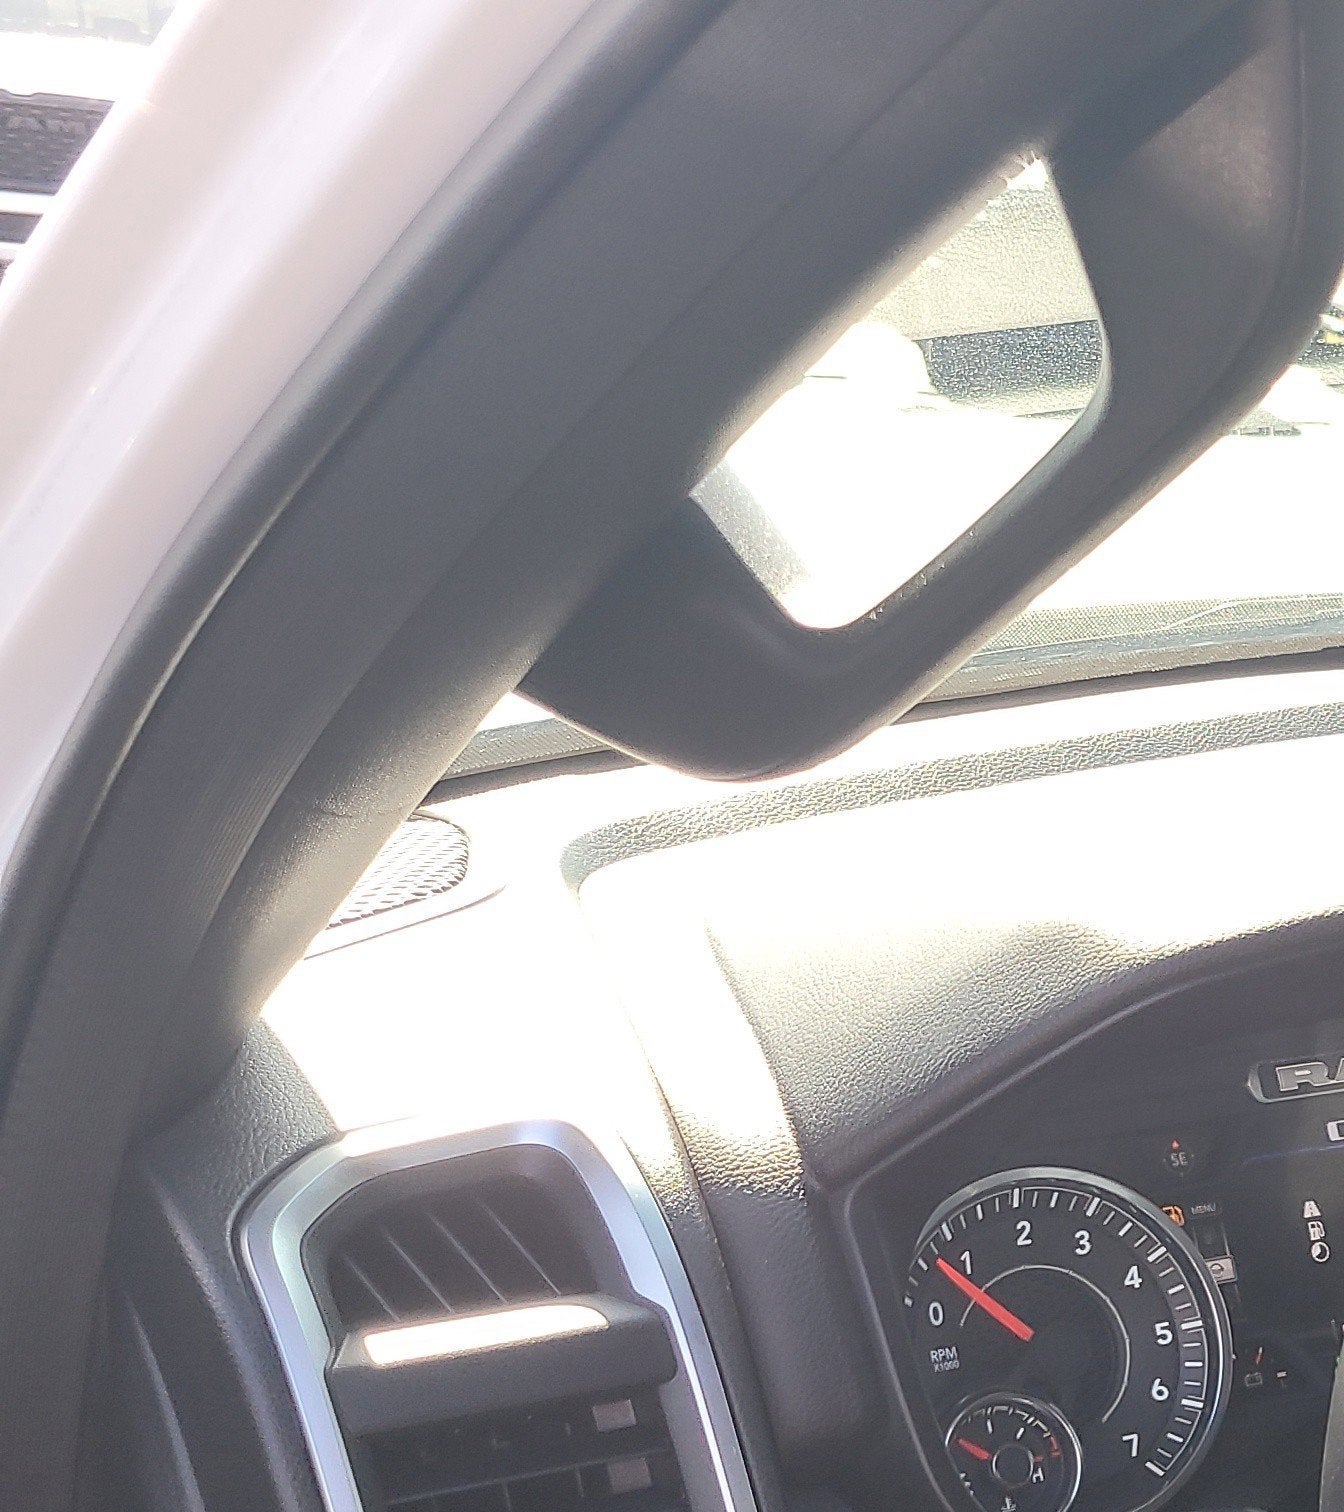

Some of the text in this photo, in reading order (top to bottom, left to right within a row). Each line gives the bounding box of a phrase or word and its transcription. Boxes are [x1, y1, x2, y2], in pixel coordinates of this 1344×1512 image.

[1170, 1151, 1188, 1167] SE
[1190, 1202, 1217, 1215] MENU
[1015, 1220, 1033, 1246] 2
[1074, 1230, 1092, 1256] 3
[960, 1250, 973, 1275] 1
[1123, 1265, 1143, 1289] 4
[928, 1301, 944, 1327] 0
[1154, 1321, 1173, 1345] 5
[930, 1346, 958, 1363] RPM
[1151, 1378, 1169, 1401] 6
[1122, 1433, 1139, 1457] 7
